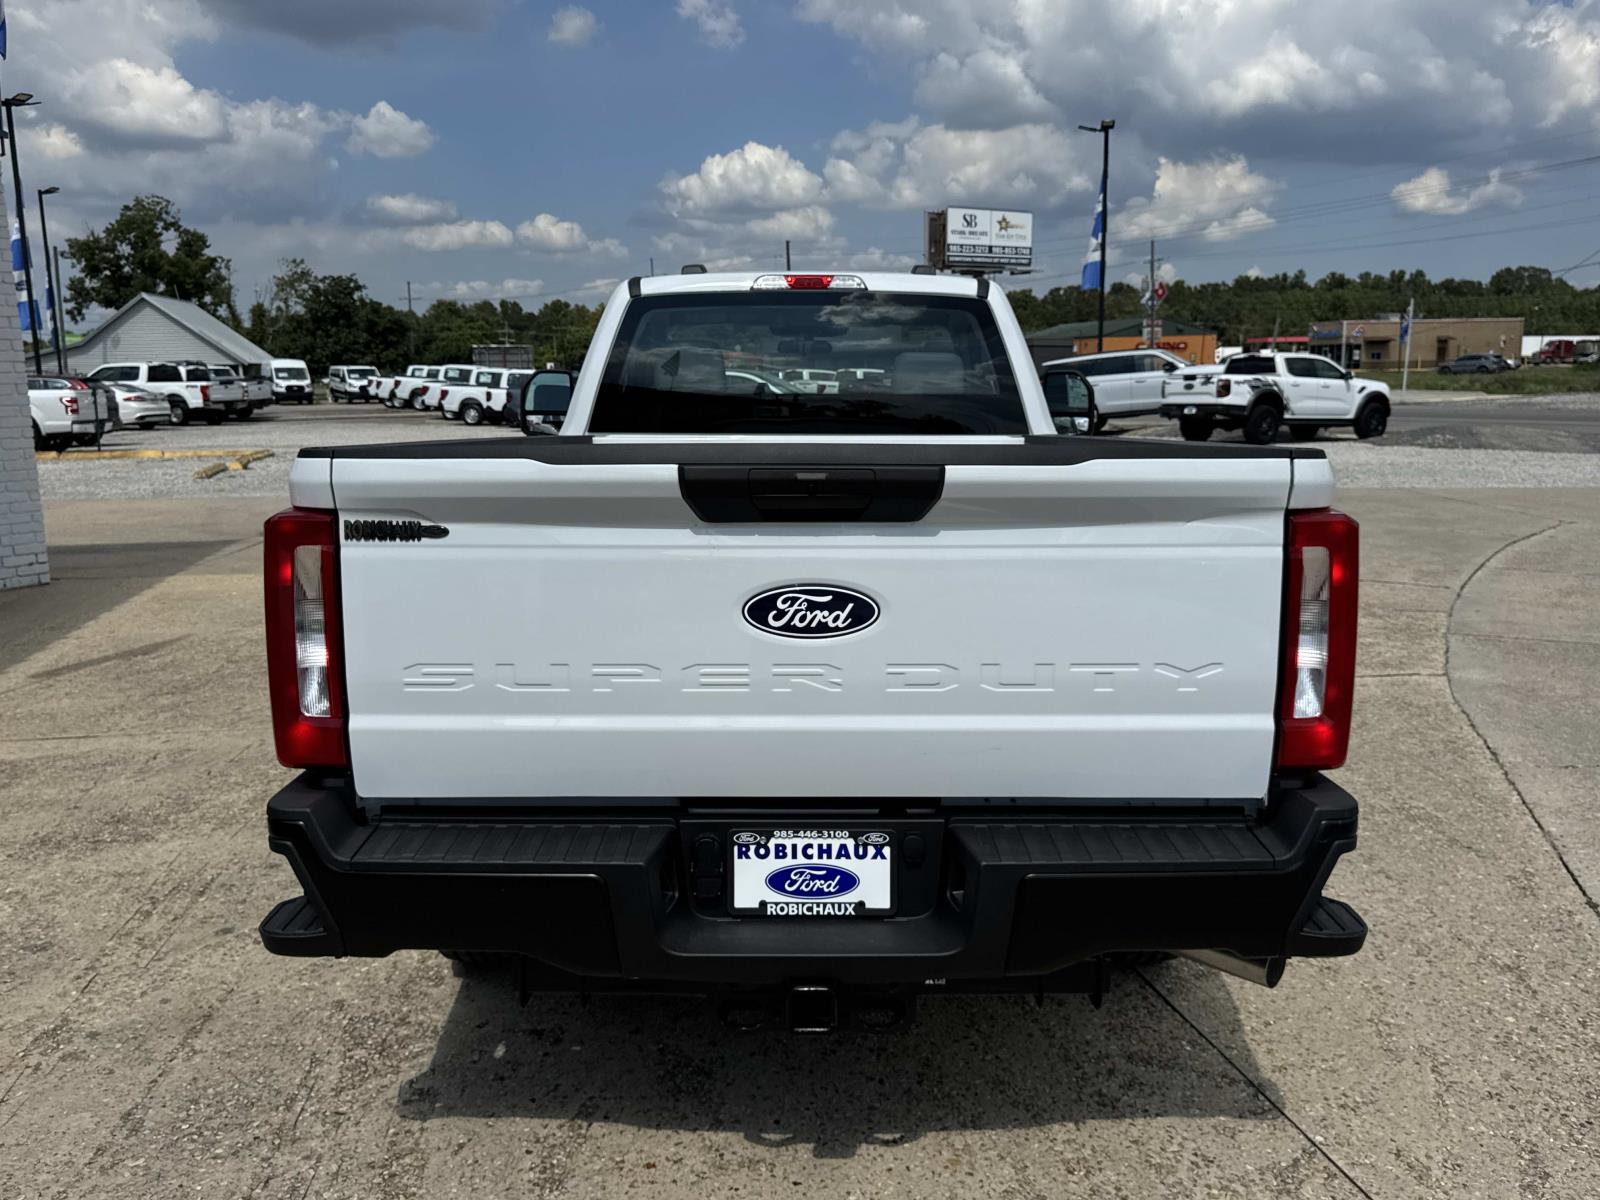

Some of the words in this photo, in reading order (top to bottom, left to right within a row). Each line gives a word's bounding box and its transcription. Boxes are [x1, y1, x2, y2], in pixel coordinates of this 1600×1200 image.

[767, 593, 855, 628] Ford
[403, 662, 843, 692] SUPER
[886, 662, 1224, 692] DUTY
[773, 830, 850, 838] 985-446-3100
[737, 843, 888, 860] ROBICHAUX
[784, 868, 841, 893] Ford
[766, 903, 856, 916] ROBICHAUX
